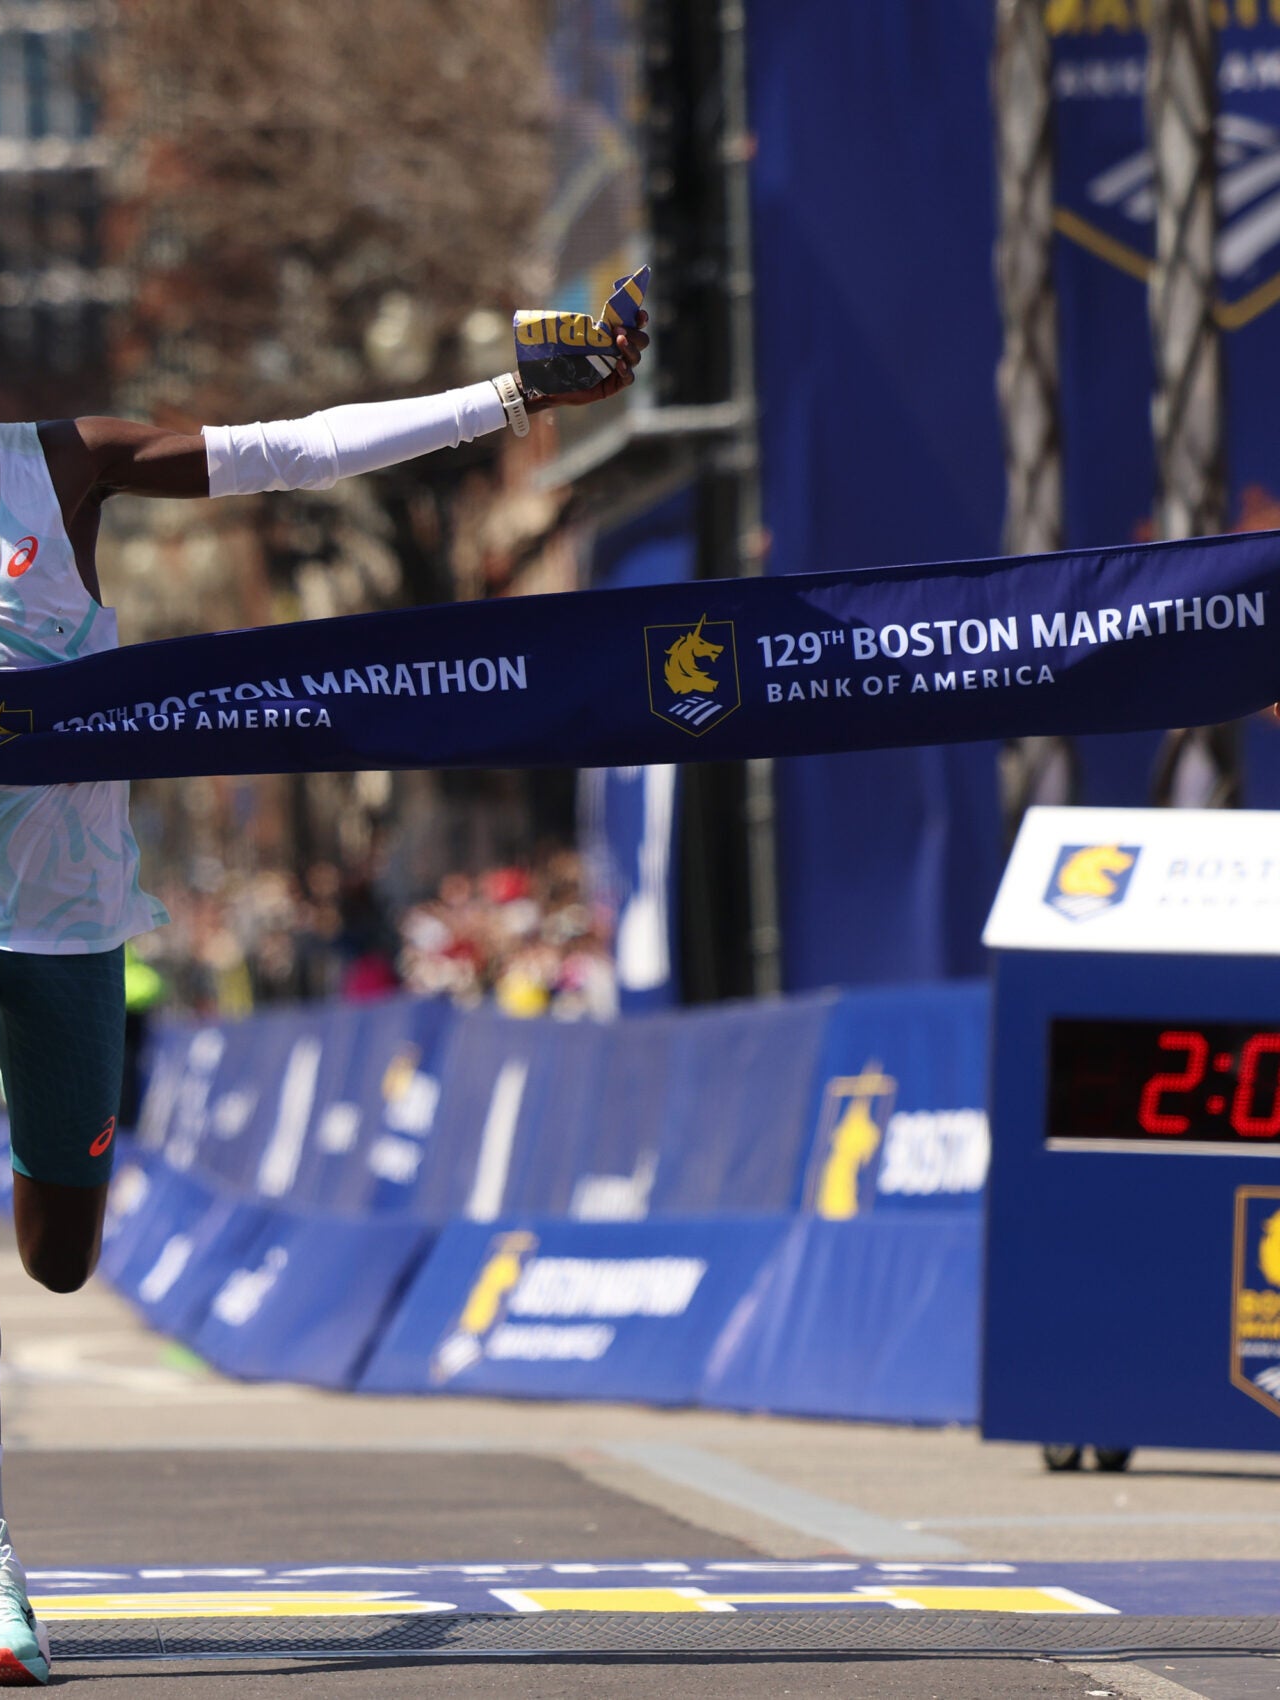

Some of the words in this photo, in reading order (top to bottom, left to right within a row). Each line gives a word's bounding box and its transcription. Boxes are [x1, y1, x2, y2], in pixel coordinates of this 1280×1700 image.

[757, 629, 846, 668] 129TH
[852, 615, 1019, 660] BOSTON
[1030, 592, 1265, 649] MARATHON
[300, 655, 528, 697] MARATHON
[767, 678, 852, 702] BANK
[863, 675, 901, 696] OF
[911, 664, 1055, 694] AMERICA
[149, 712, 187, 731] OF
[195, 707, 332, 731] AMERICA
